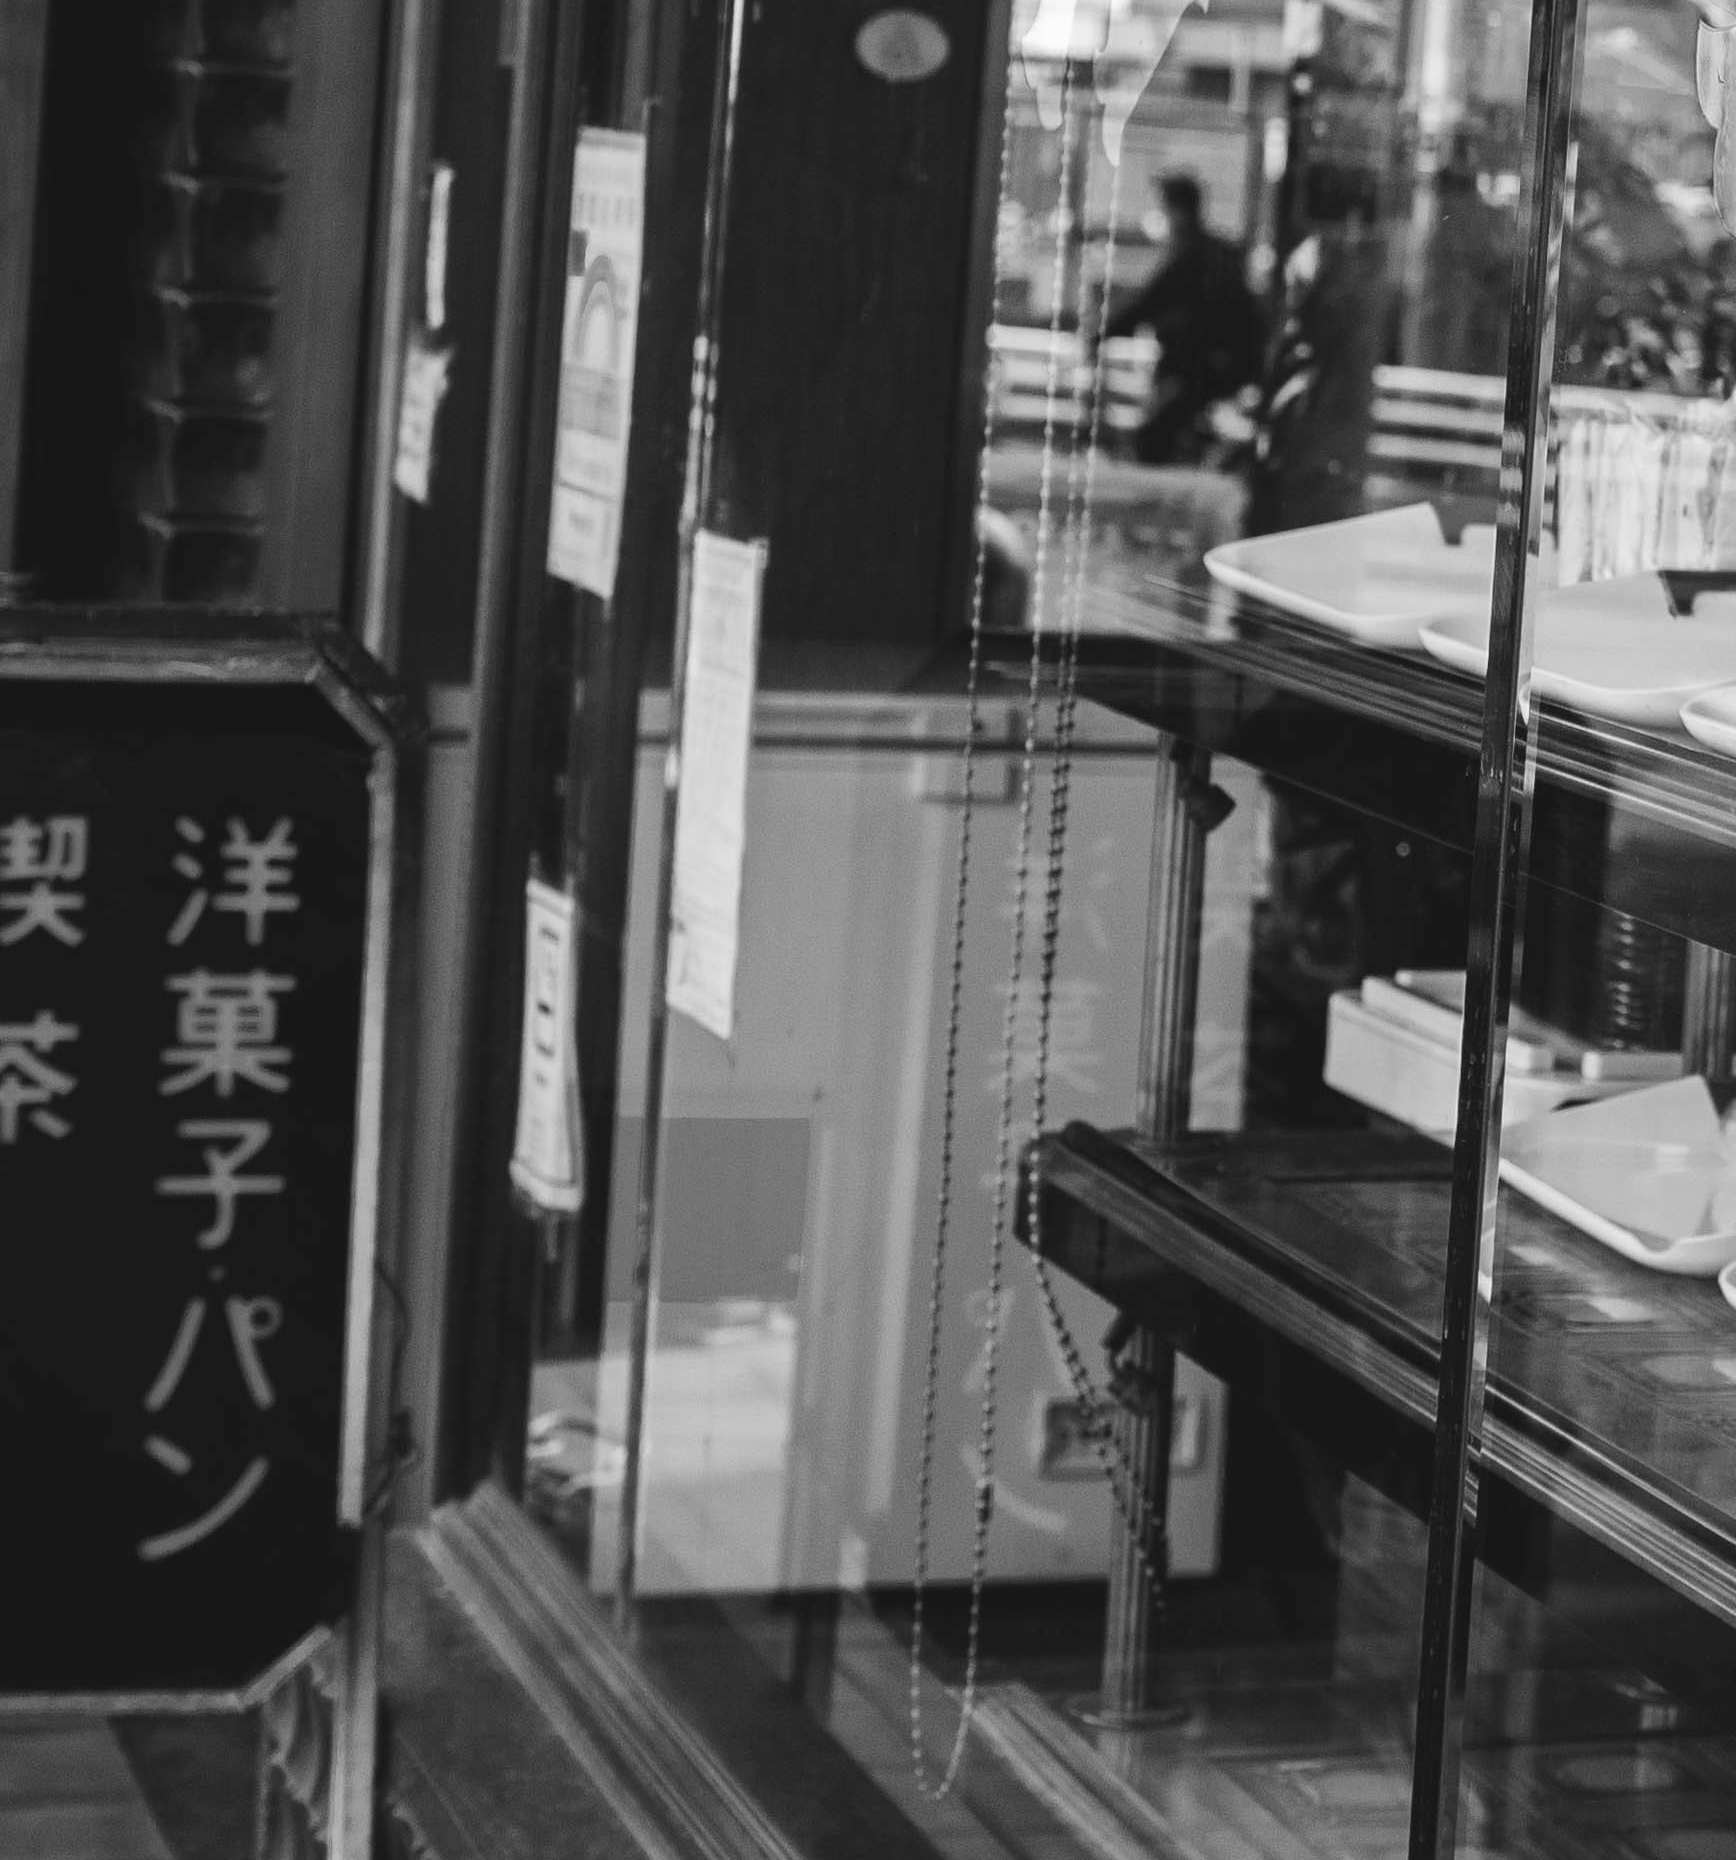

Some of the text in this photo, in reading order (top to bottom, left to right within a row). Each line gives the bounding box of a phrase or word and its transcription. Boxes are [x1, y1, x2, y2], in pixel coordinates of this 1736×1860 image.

[138, 812, 300, 1560] 洋菓子・パン
